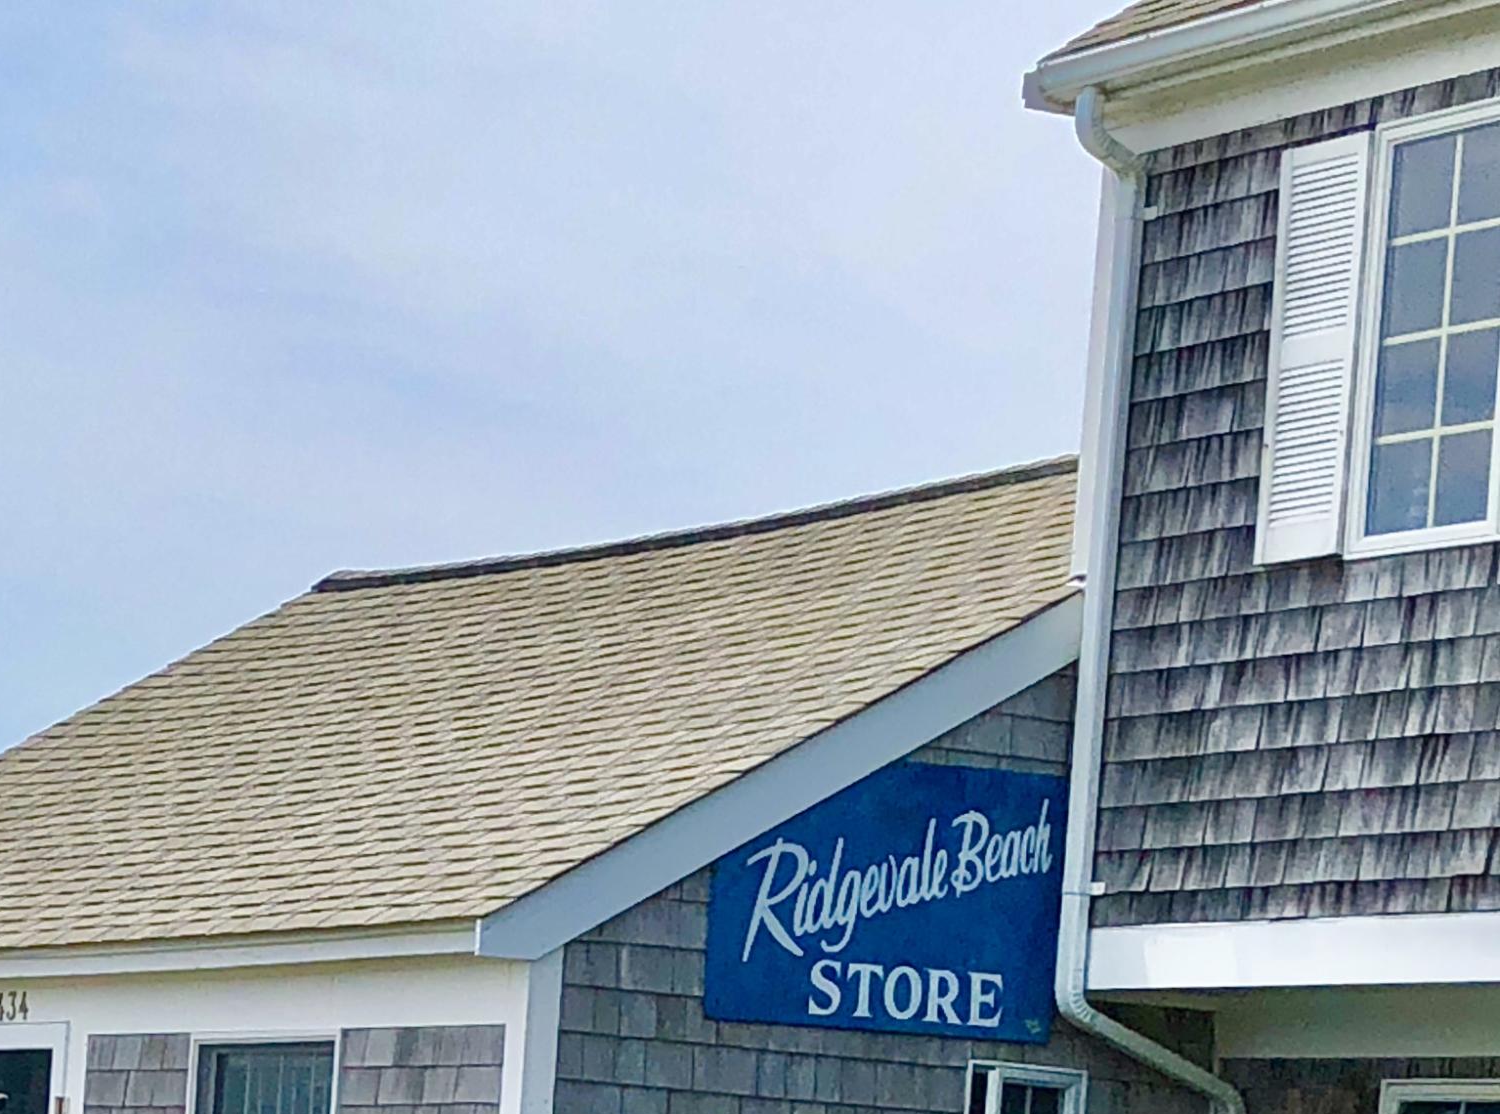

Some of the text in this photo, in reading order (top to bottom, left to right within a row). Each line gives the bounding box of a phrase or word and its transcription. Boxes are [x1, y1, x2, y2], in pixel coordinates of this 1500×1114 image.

[742, 798, 1052, 962] Ridgevale Beach
[808, 959, 1003, 1027] STORE
